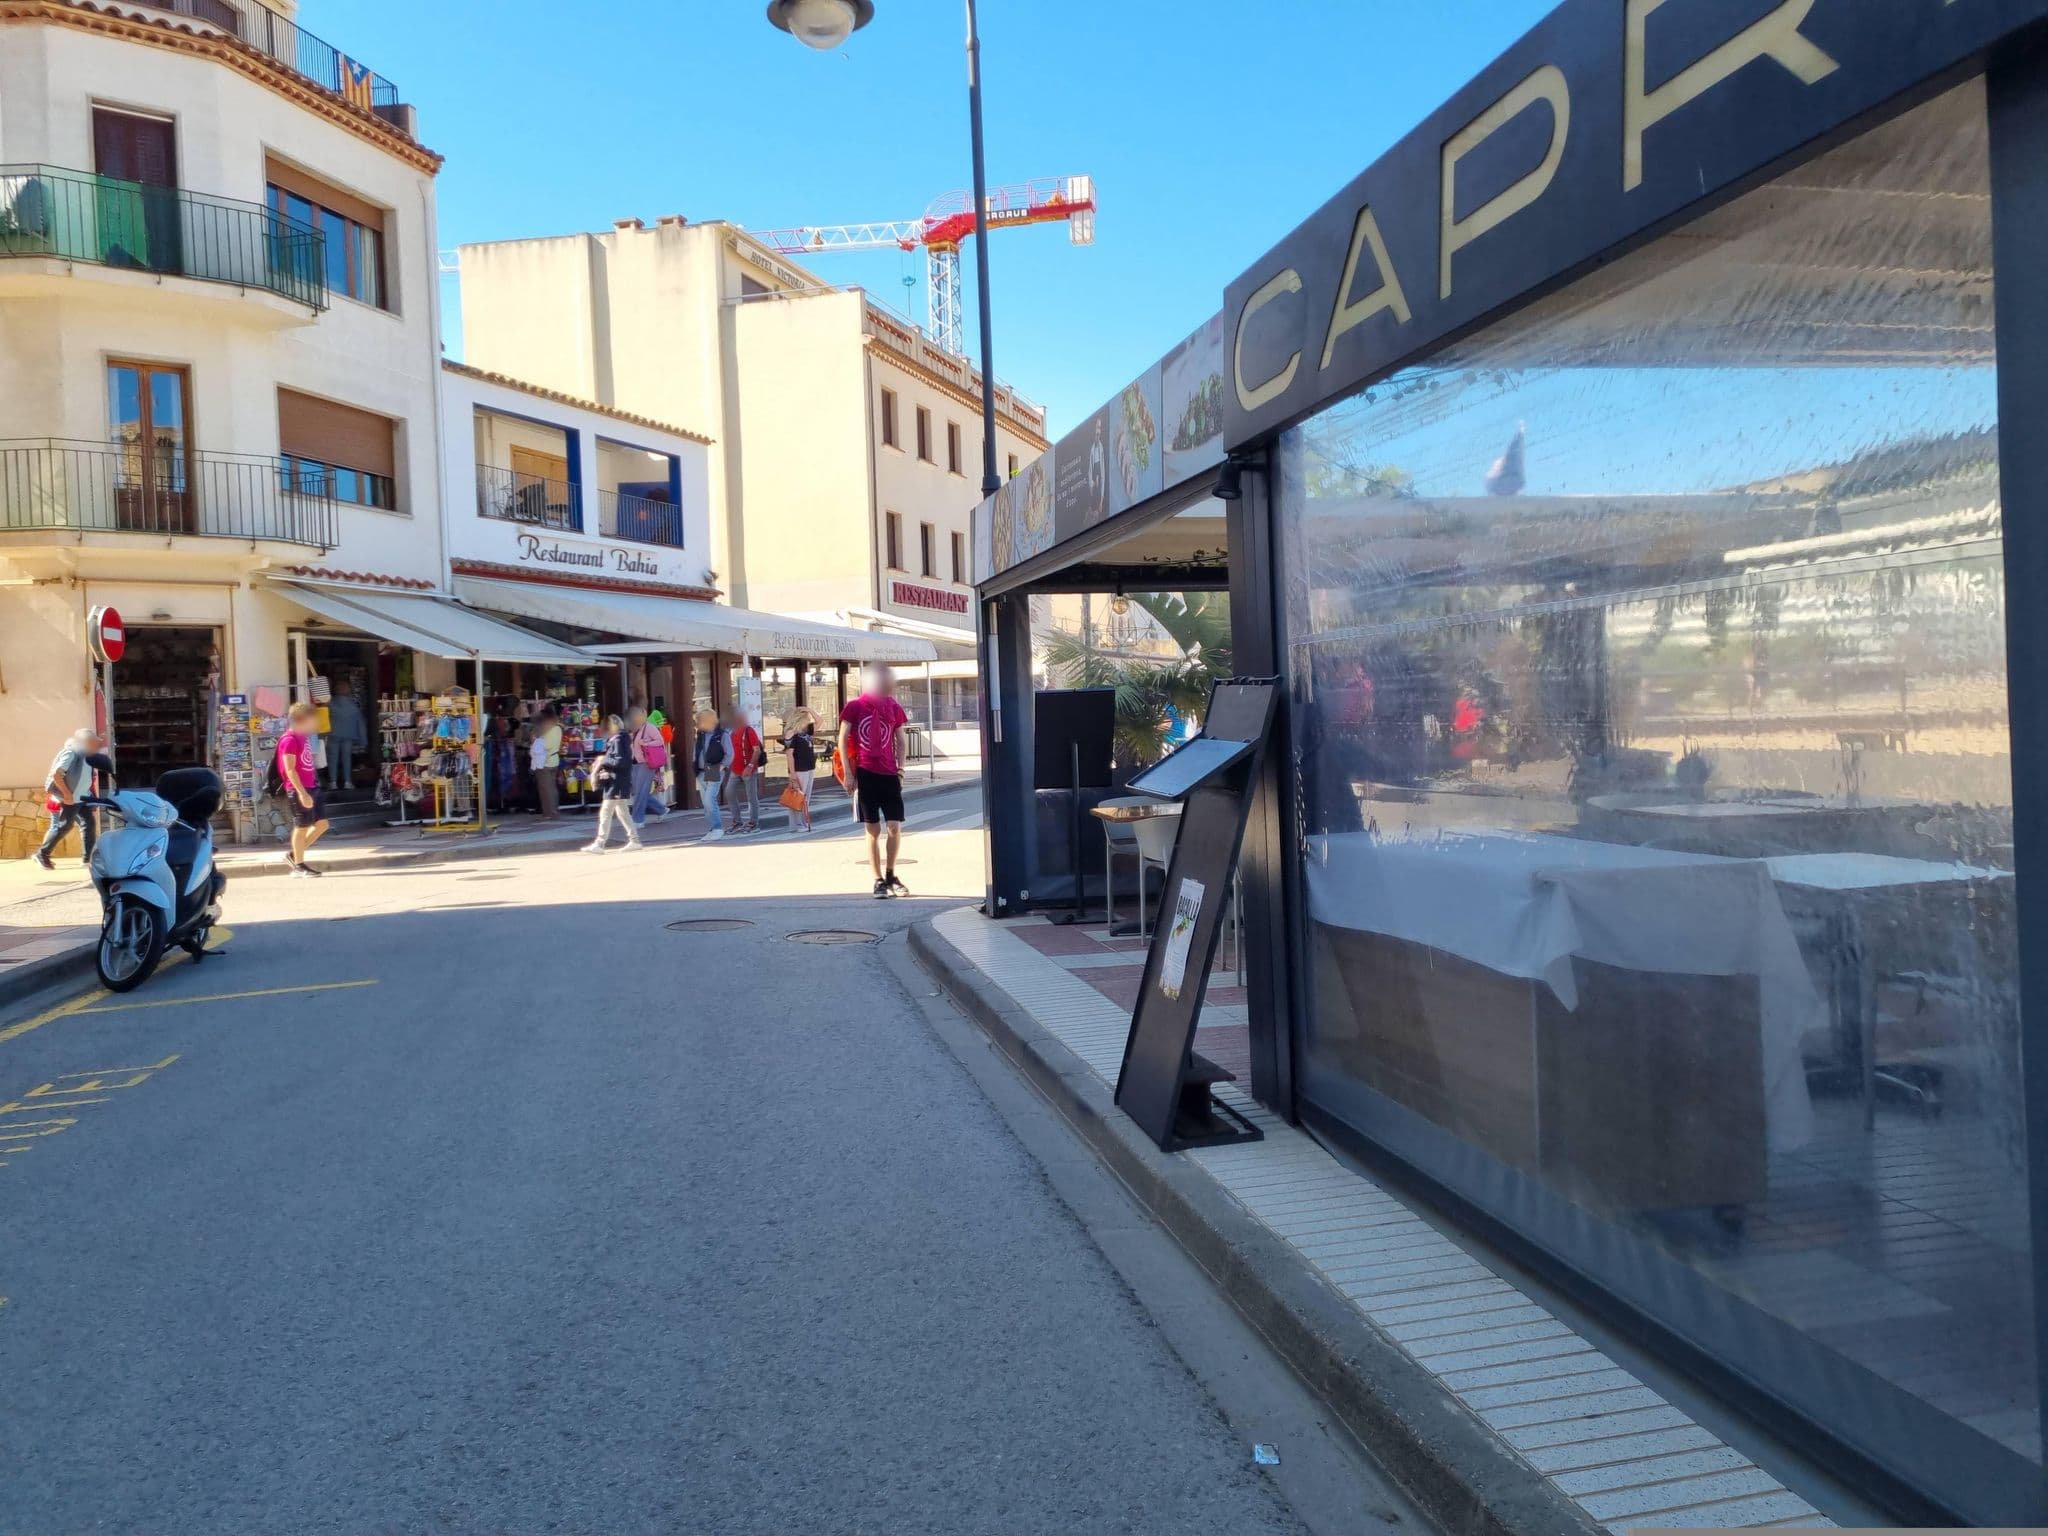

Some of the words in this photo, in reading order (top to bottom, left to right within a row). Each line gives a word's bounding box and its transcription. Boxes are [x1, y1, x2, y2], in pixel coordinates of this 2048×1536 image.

[1233, 0, 1957, 412] CAPR
[750, 251, 773, 272] HOTEL
[517, 534, 604, 568] Restaurant
[610, 548, 658, 576] Bahia
[893, 581, 969, 614] RESTAURANT
[773, 631, 831, 653] Restaurant
